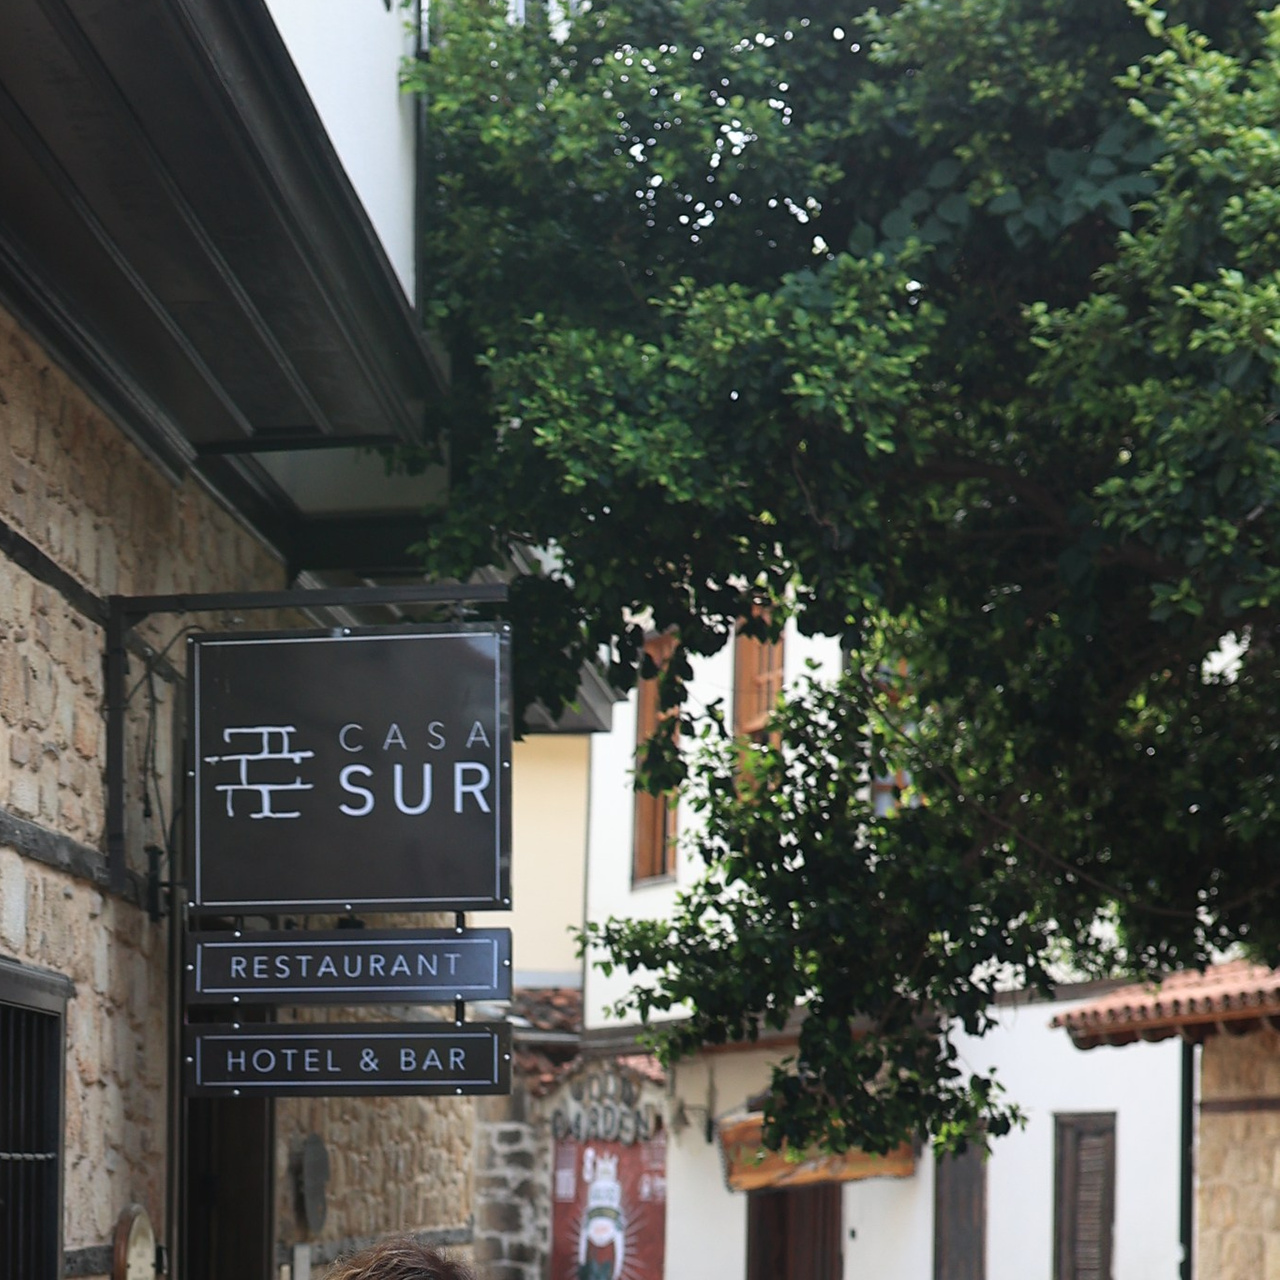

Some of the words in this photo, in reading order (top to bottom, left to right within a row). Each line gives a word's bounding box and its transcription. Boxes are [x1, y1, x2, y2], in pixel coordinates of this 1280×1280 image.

[338, 720, 491, 752] CASA
[338, 761, 491, 817] SUR
[230, 953, 462, 978] RESTAURANT
[227, 1049, 341, 1072] HOTEL
[358, 1048, 380, 1072] &
[400, 1047, 466, 1071] BAR
